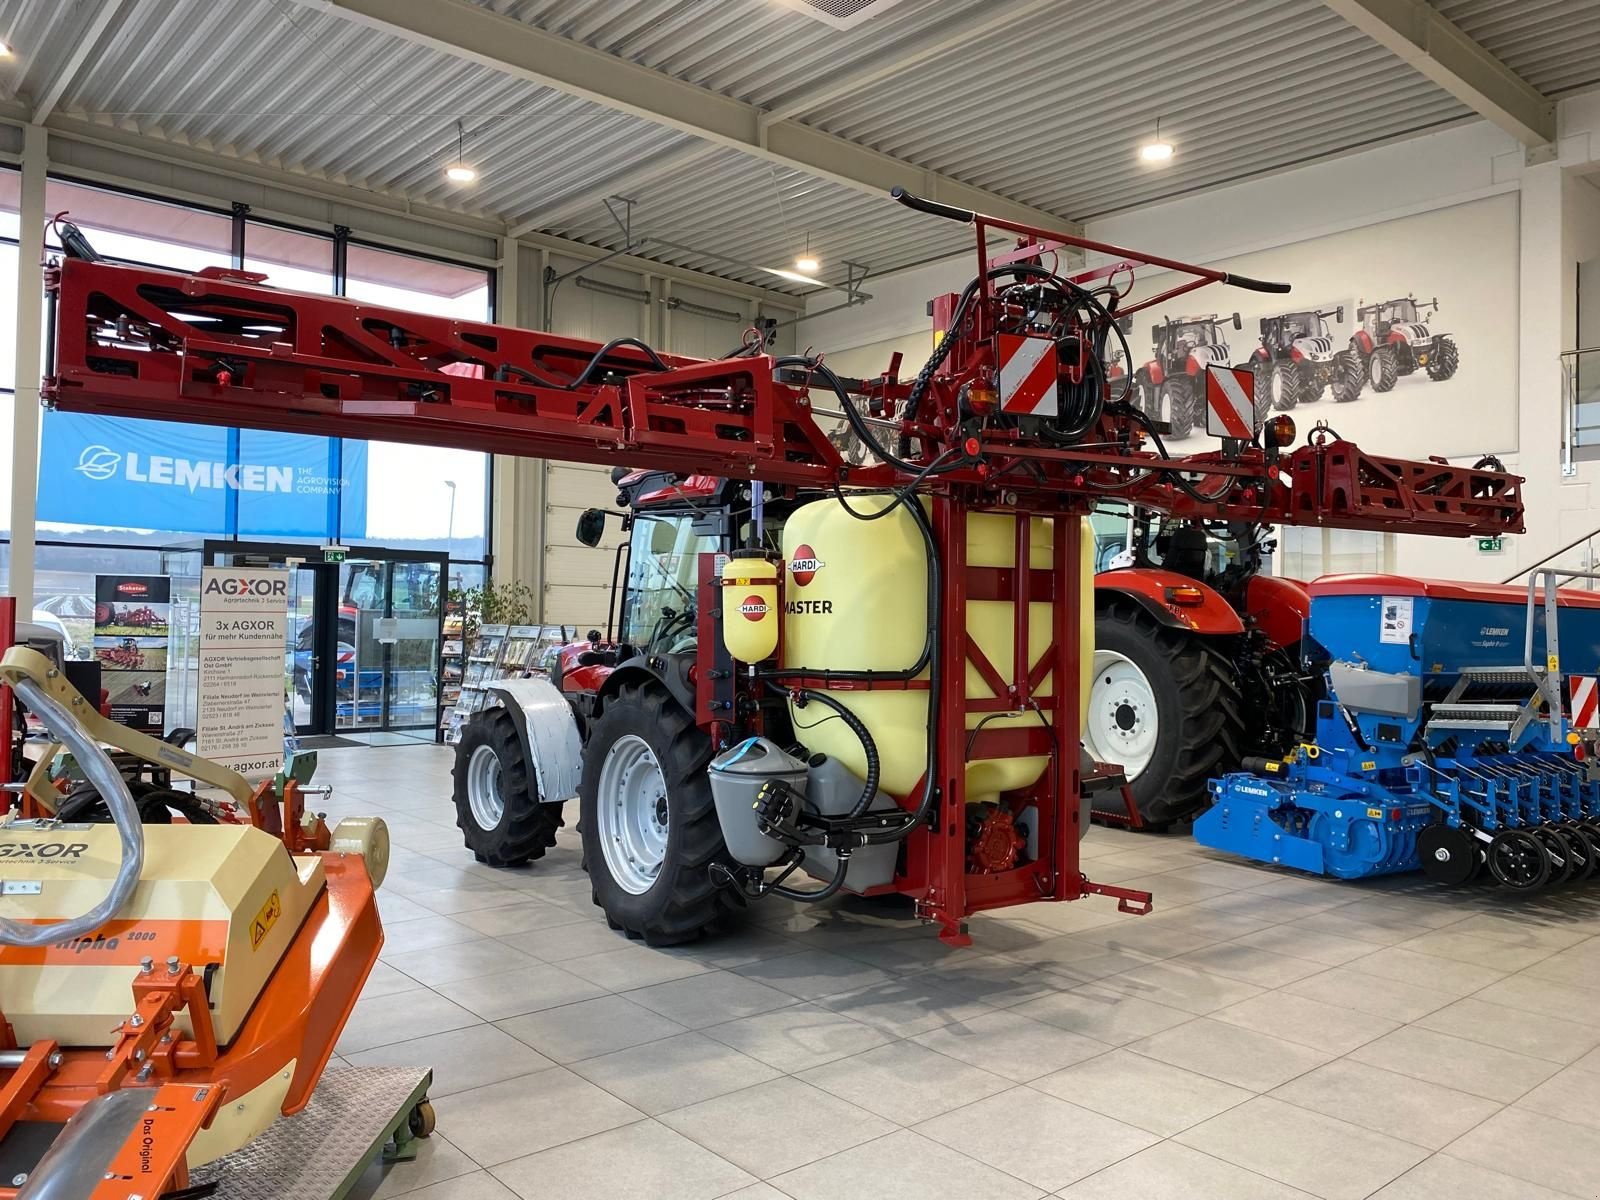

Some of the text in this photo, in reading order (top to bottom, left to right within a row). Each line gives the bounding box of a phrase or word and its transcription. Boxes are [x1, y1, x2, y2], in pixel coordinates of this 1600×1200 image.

[125, 452, 293, 494] LEMKEN
[298, 467, 312, 475] THE
[297, 476, 350, 487] AGROVISION
[297, 485, 341, 495] COMPANY
[792, 560, 816, 571] HARDI
[204, 577, 286, 596] AGXOR
[216, 620, 275, 630] 3x AGXOR
[1486, 628, 1509, 636] LEMKEN
[224, 758, 279, 773] agxor.at
[1241, 785, 1268, 797] LEMKEN
[0, 843, 89, 858] GXOR
[127, 932, 157, 941] 2000
[139, 1119, 154, 1173] Das Original
